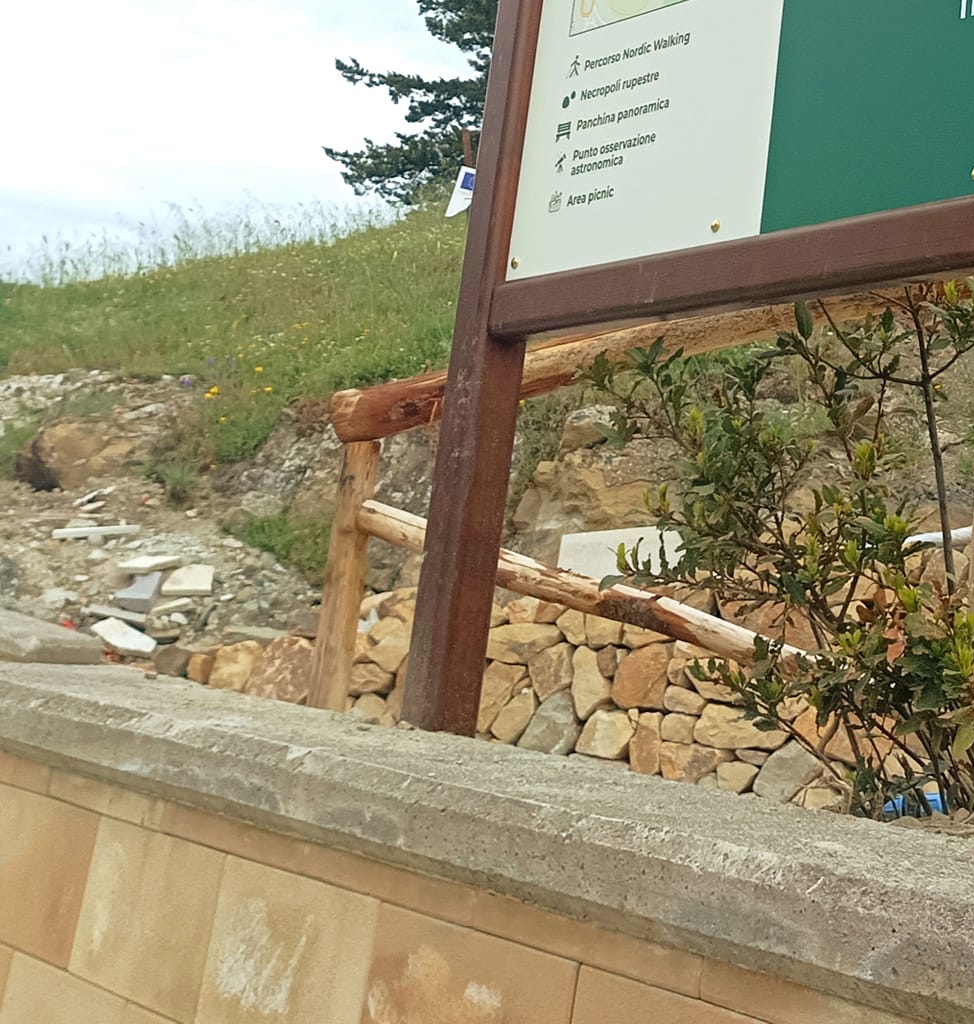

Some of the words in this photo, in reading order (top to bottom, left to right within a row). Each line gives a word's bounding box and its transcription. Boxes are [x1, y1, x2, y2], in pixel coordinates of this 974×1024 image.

[584, 54, 621, 71] Percorso
[622, 43, 651, 59] Nordic
[653, 31, 690, 51] Walking
[581, 80, 621, 102] Necropoli
[621, 70, 659, 92] rupestre
[576, 112, 616, 131] Panchina
[617, 97, 670, 123] panoramica
[572, 147, 598, 161] Punto
[599, 131, 656, 156] osservazione
[570, 155, 623, 176] astronomica
[566, 193, 587, 207] Area
[588, 186, 615, 205] picnic
